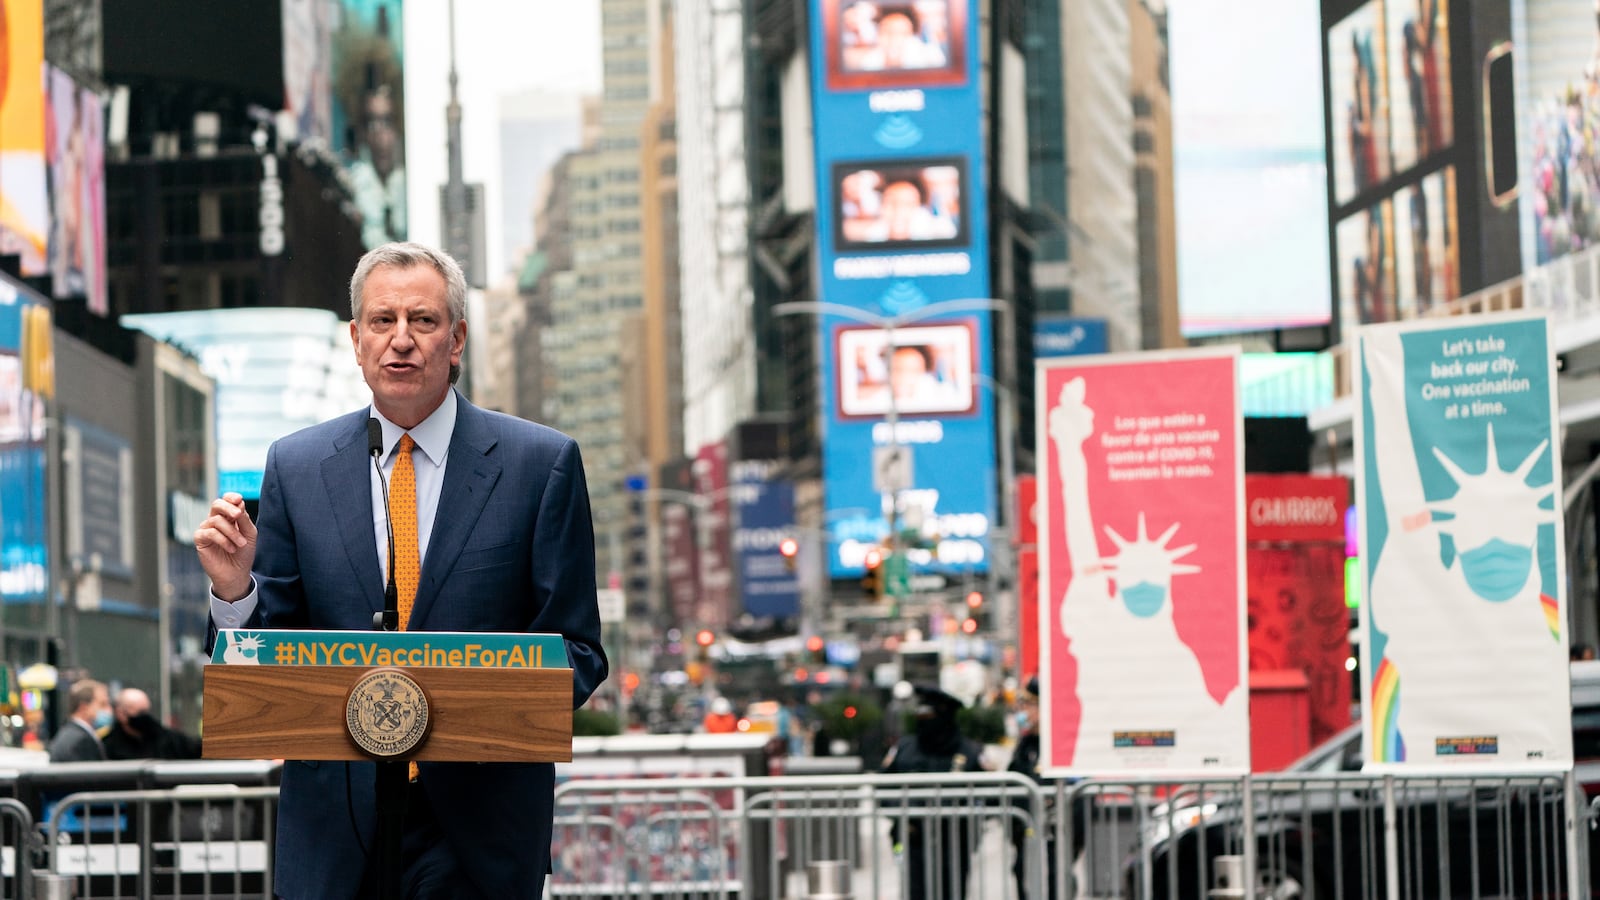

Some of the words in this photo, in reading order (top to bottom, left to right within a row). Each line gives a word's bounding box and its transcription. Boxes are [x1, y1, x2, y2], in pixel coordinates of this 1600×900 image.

[1442, 339, 1474, 358] Let's
[1475, 334, 1506, 354] take
[1431, 359, 1464, 379] back
[1466, 361, 1489, 376] our
[1491, 355, 1519, 377] city.
[1421, 382, 1451, 401] One
[1453, 377, 1530, 398] vaccination
[1445, 403, 1459, 419] at
[1461, 404, 1470, 418] a
[1472, 399, 1507, 417] time.
[1177, 429, 1220, 443] vacuna
[1106, 450, 1145, 464] contra
[1108, 464, 1160, 481] levanten
[1175, 463, 1213, 478] mano.
[1249, 496, 1338, 527] CHURROS
[274, 642, 542, 668] #NYCVaccineForAll
